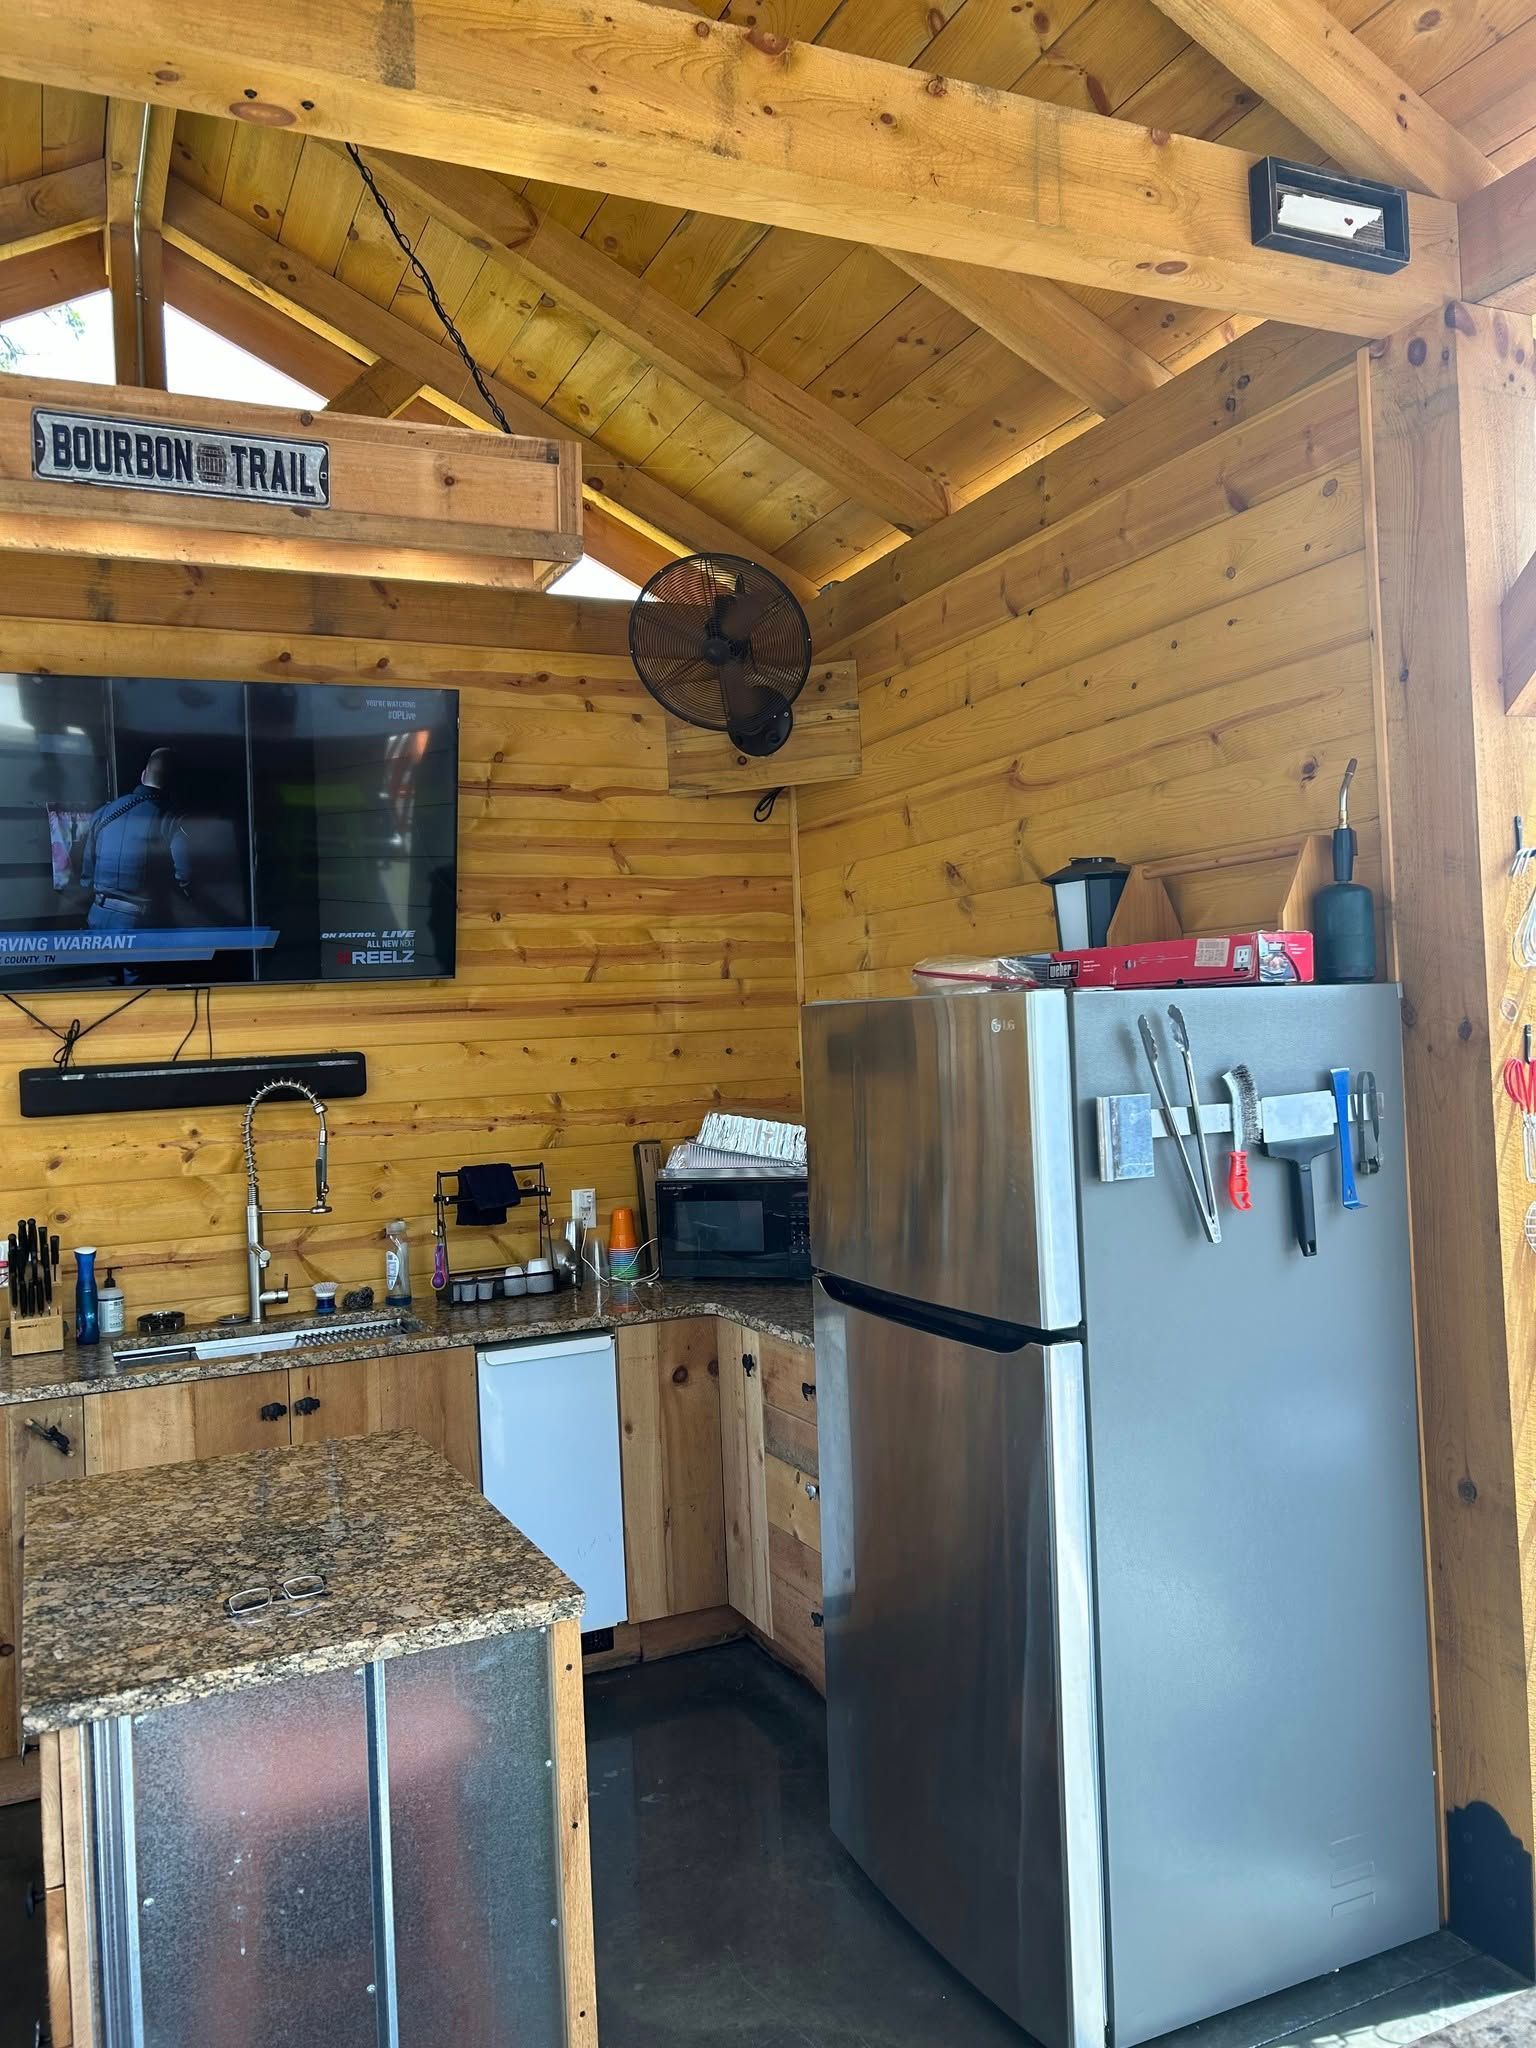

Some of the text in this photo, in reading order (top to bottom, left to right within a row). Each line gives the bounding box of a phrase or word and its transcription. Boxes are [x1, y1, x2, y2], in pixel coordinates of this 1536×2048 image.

[51, 423, 317, 497] BOURBON TRAIL
[382, 930, 416, 938] LIVE
[53, 935, 137, 950] WARRANT
[366, 939, 415, 948] ALL NEW NEXT
[44, 954, 56, 963] TN
[351, 950, 415, 965] REELZ
[1049, 961, 1072, 978] weber
